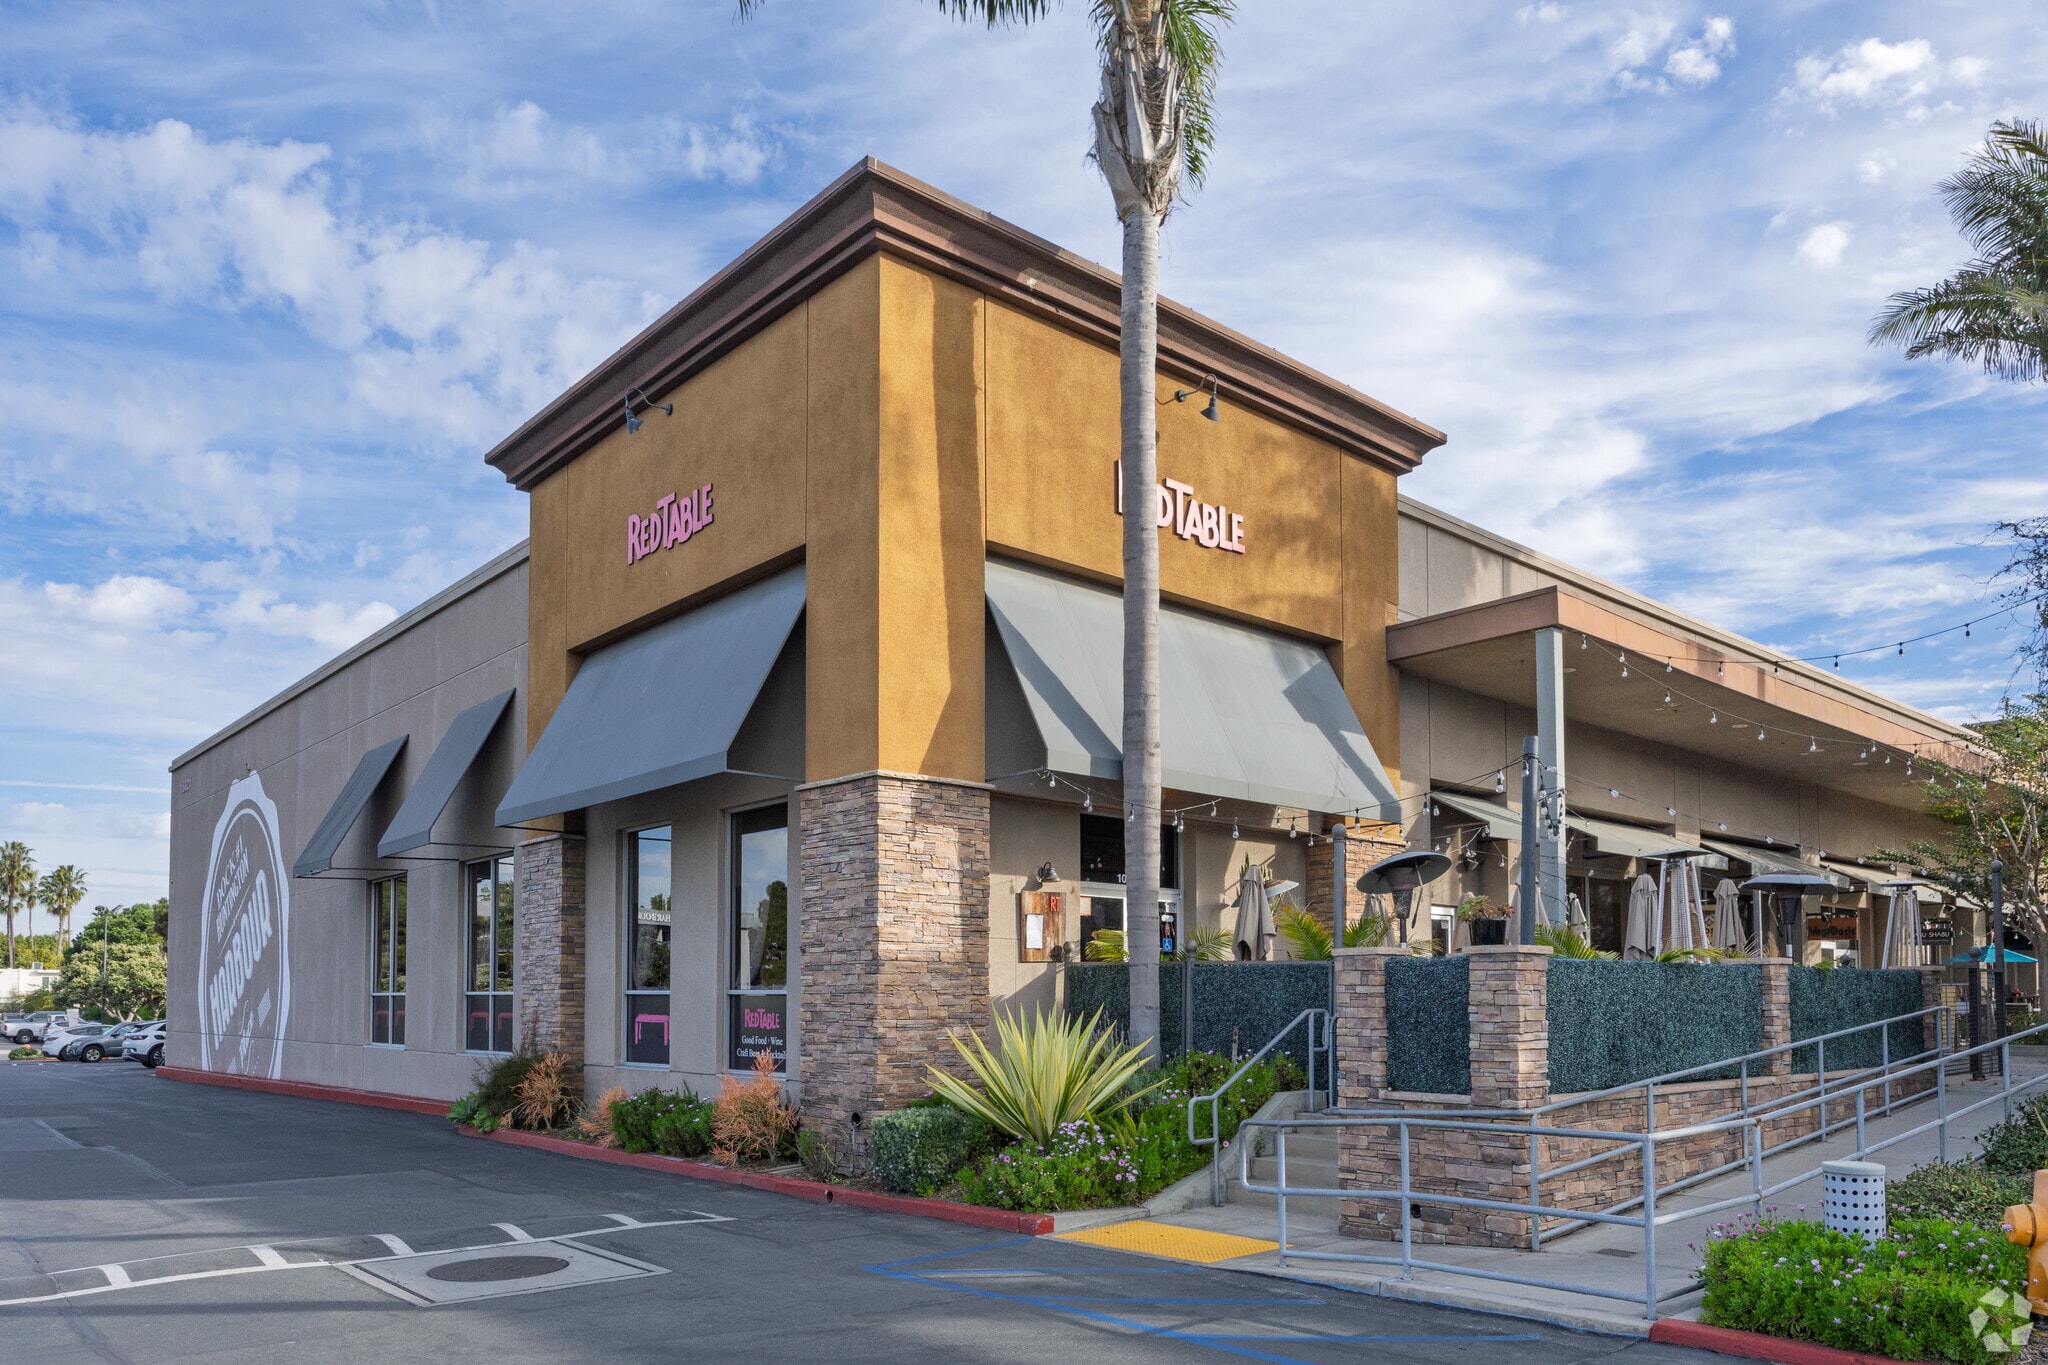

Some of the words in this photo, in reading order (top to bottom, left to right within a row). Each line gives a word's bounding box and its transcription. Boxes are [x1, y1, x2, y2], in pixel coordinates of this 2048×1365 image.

[216, 851, 236, 911] DOCK
[216, 847, 250, 943] HUNTINGTON
[1050, 896, 1061, 912] RT
[209, 869, 273, 1051] HARBOUR
[736, 1048, 749, 1057] Craft
[741, 1035, 755, 1045] Good
[754, 1036, 768, 1046] Food
[770, 1036, 783, 1046] Wine
